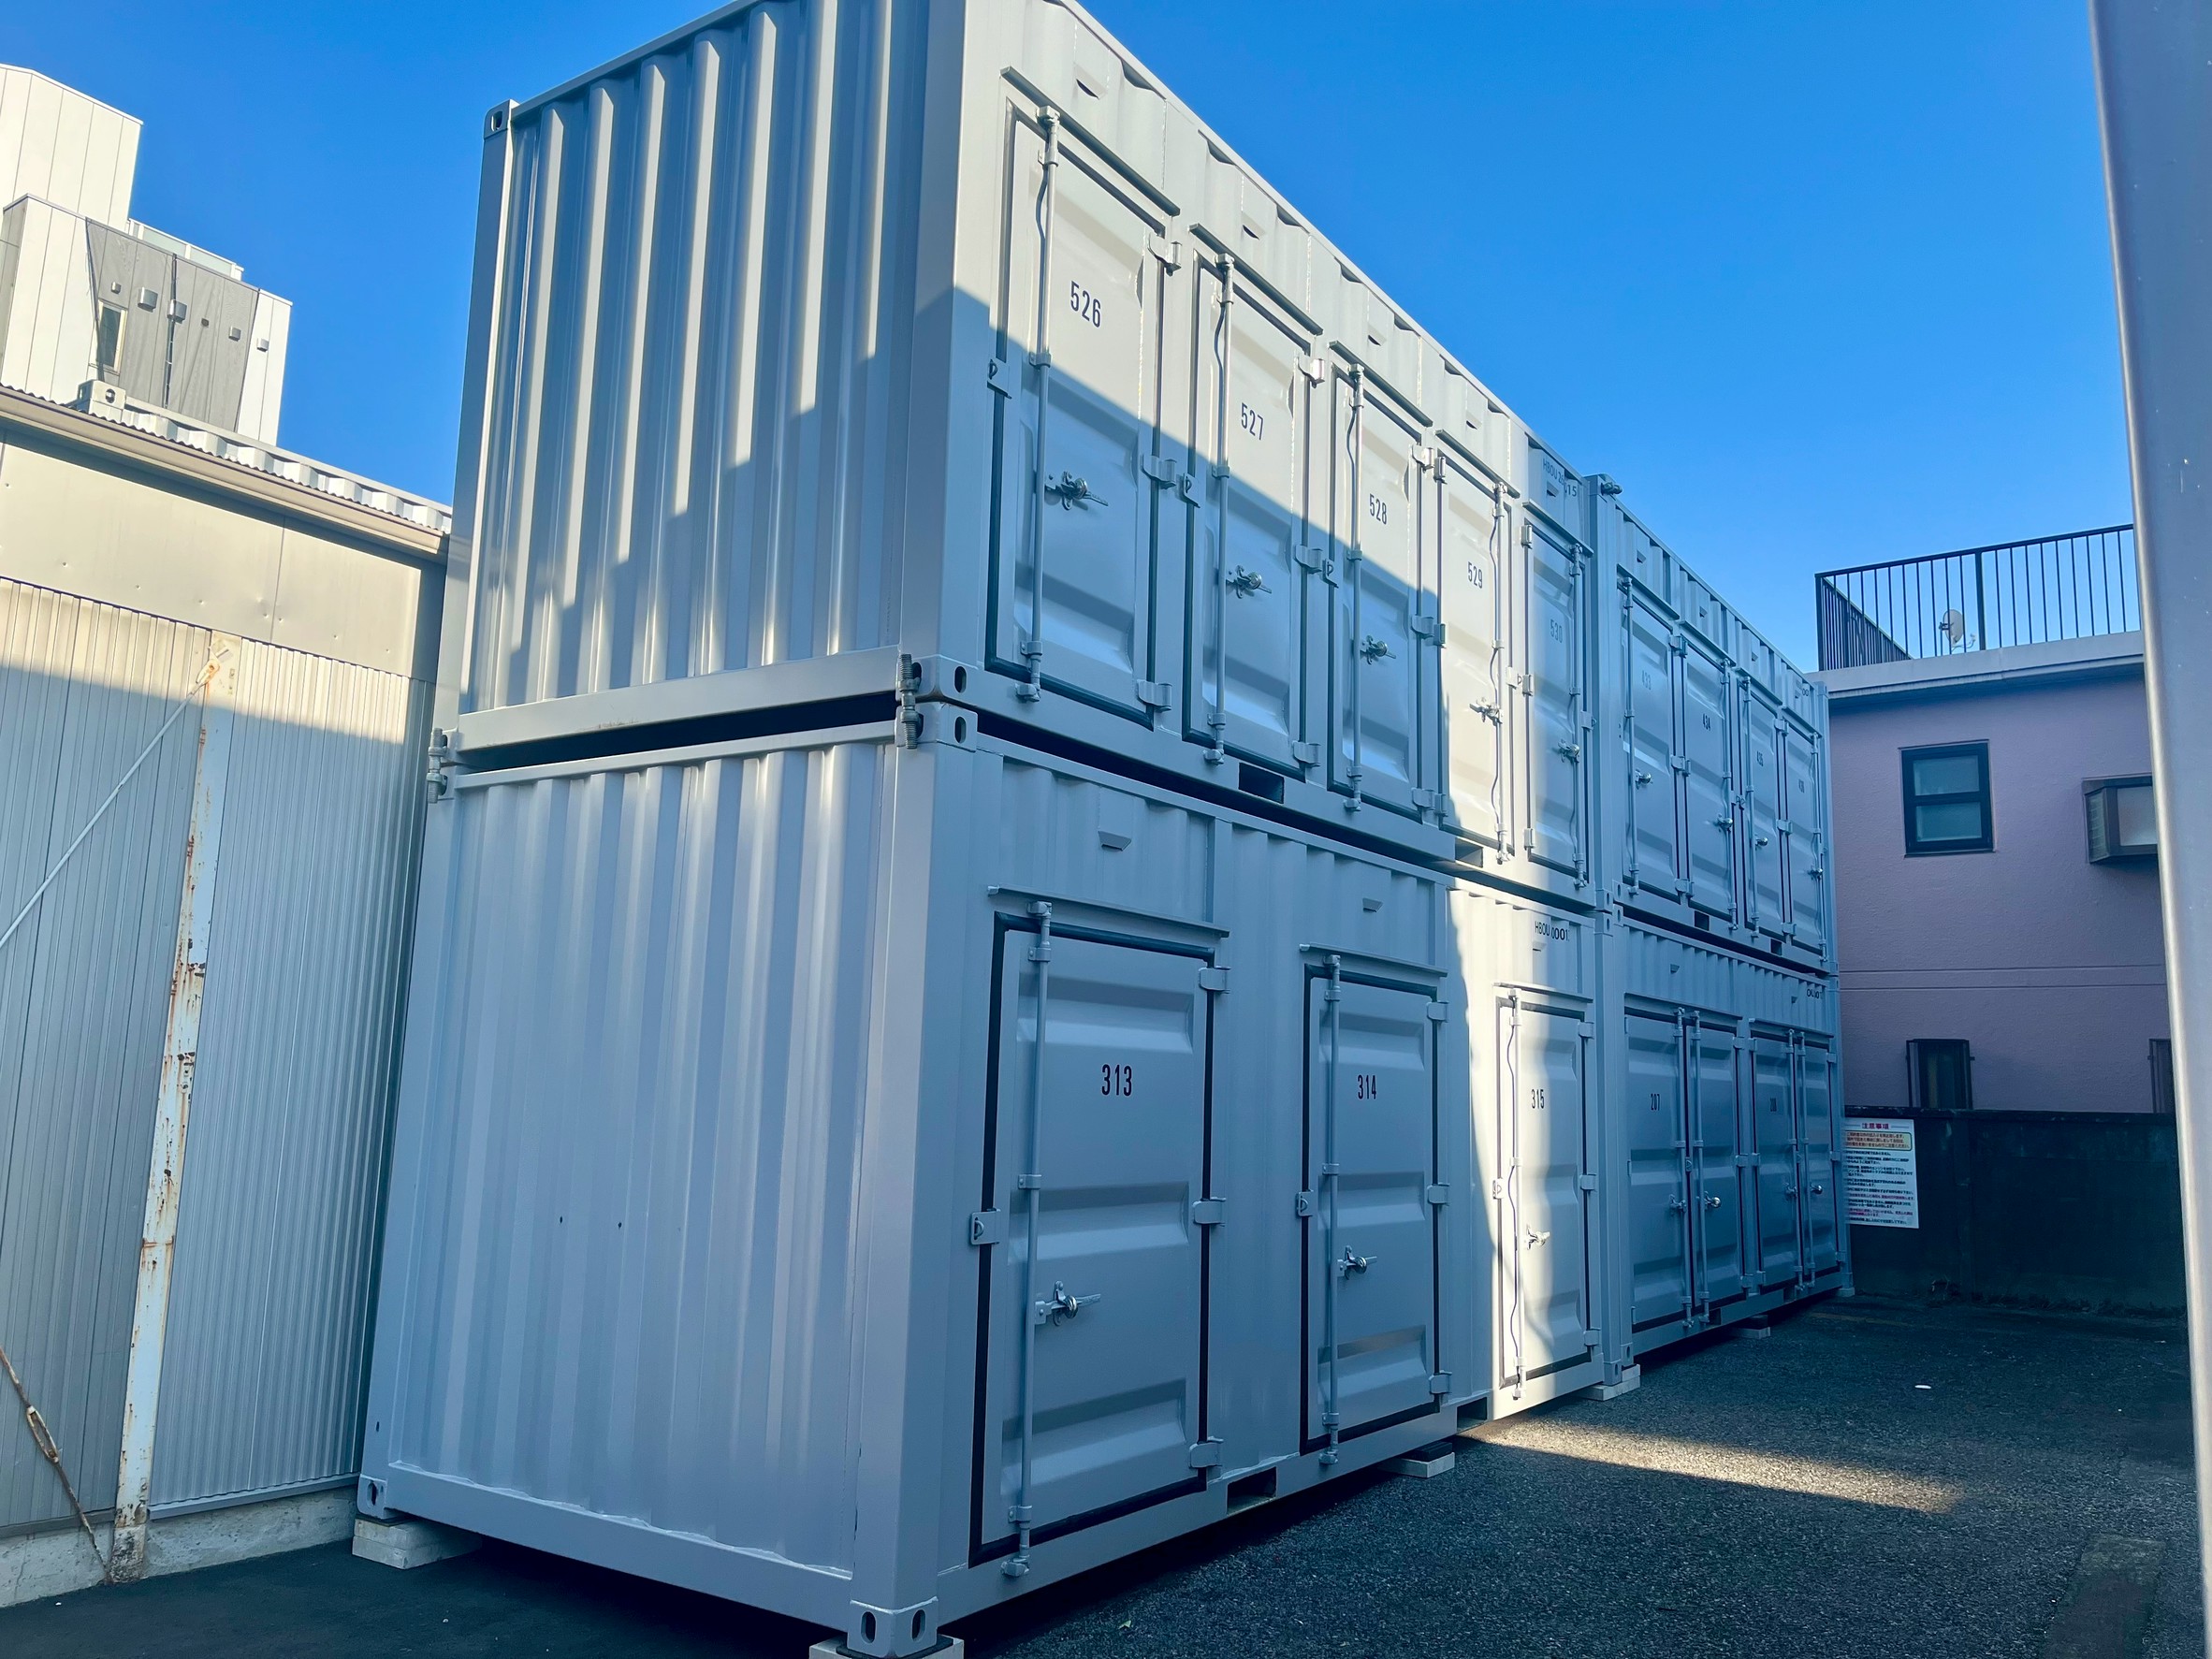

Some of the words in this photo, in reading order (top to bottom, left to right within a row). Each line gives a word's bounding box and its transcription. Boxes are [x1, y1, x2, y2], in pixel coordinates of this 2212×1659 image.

[1070, 280, 1102, 328] 526
[1240, 401, 1264, 442] 527
[1368, 492, 1389, 526] 528
[1467, 561, 1483, 589] 529
[1550, 618, 1564, 644] 530
[1702, 713, 1711, 732] 434
[1534, 920, 1550, 937] HBOU
[1100, 1064, 1134, 1098] 313
[1357, 1074, 1377, 1100] 314
[1531, 1088, 1545, 1110] 315
[1650, 1093, 1661, 1112] 207
